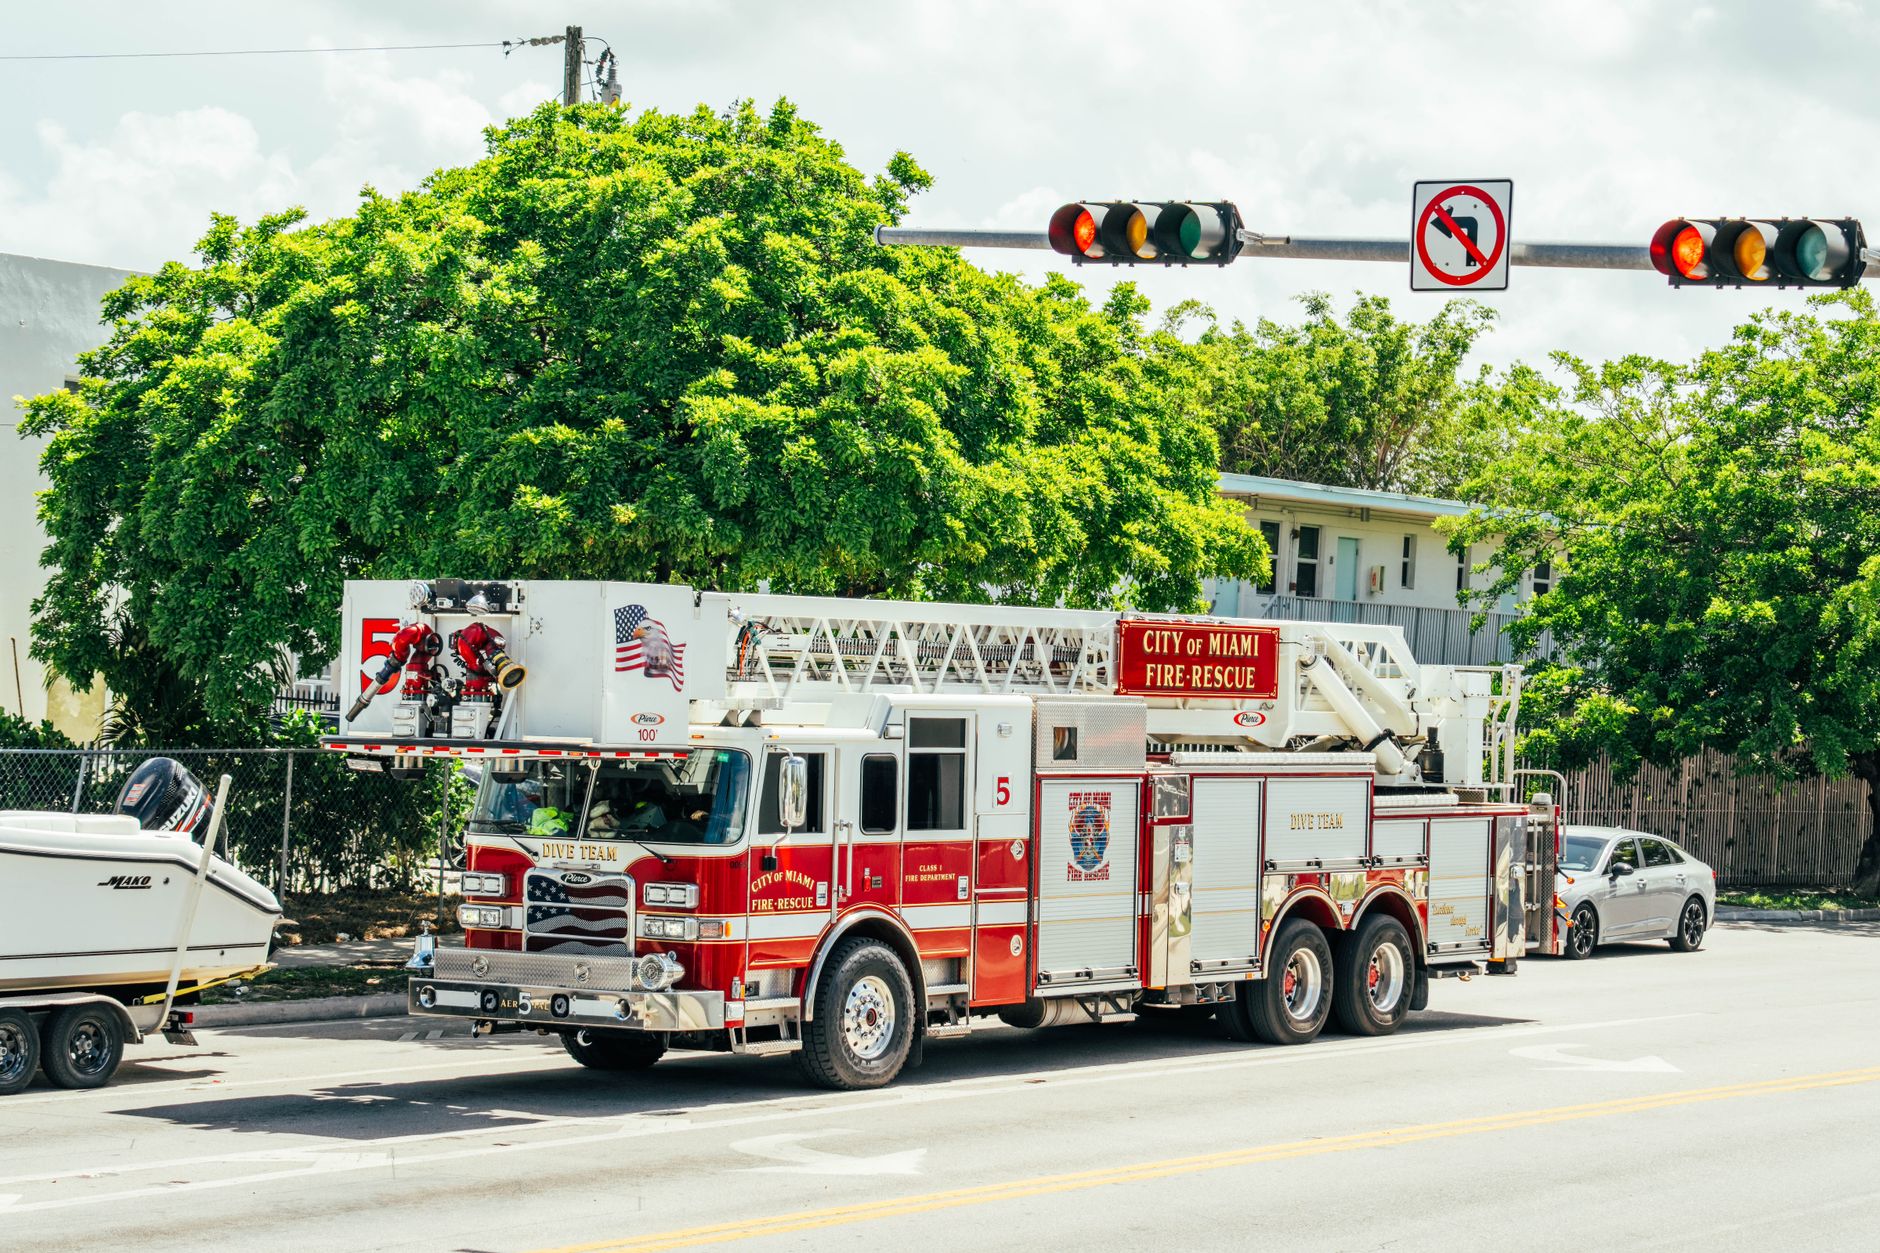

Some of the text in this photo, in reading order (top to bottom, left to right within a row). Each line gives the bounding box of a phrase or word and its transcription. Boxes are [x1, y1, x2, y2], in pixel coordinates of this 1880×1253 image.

[1142, 630, 1259, 658] CITY OF MIAMI
[360, 618, 402, 696] 5
[1240, 713, 1259, 724] Pierce
[996, 776, 1011, 806] 5
[159, 786, 199, 831] SUZUKI
[1290, 812, 1343, 830] DIVE TEAM
[542, 843, 617, 861] DIVE TEAM
[905, 872, 956, 882] FIRE DEPARTMENT
[919, 864, 938, 872] CLASS
[97, 875, 152, 889] MAKO
[563, 872, 588, 883] Pierce
[751, 869, 815, 893] CITY OF MIAMI
[518, 992, 532, 1015] 5
